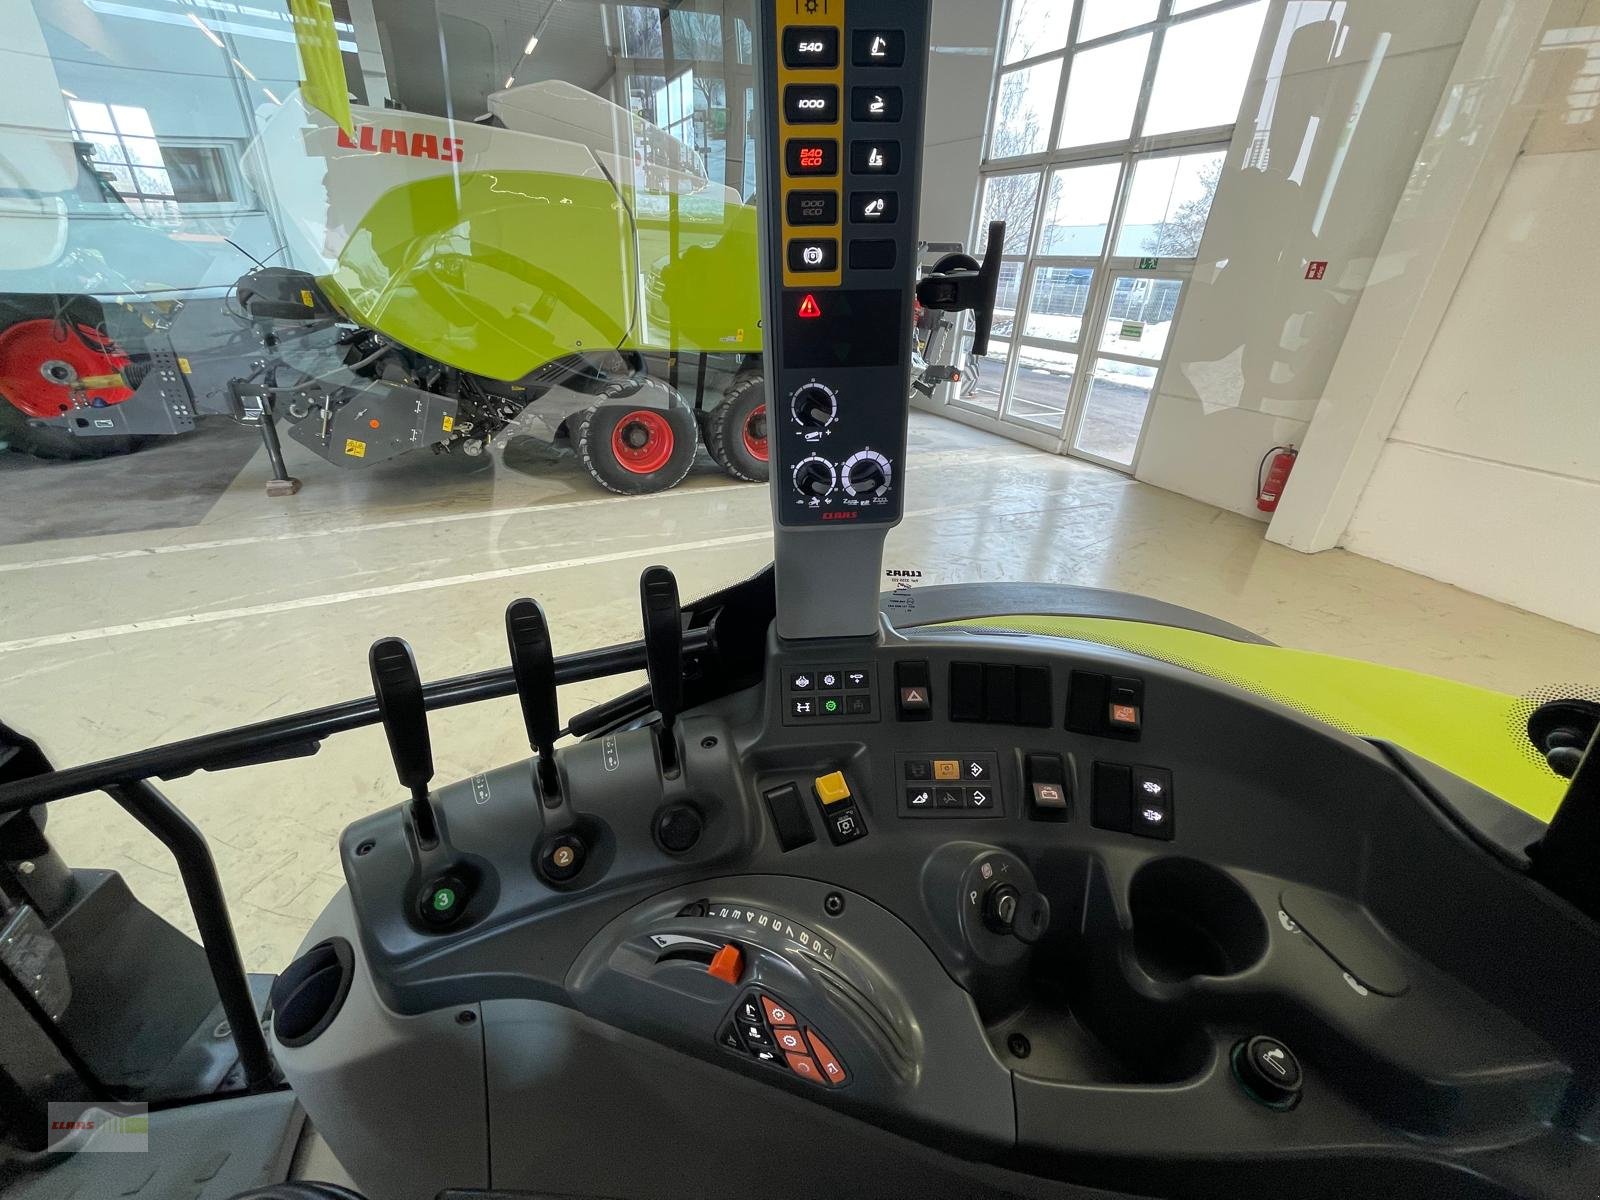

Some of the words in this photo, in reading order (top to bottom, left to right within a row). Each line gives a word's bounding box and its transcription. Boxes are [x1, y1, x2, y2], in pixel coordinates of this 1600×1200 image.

[799, 42, 823, 52] 540
[799, 99, 825, 109] 1000
[801, 149, 823, 157] 540
[801, 157, 823, 166] ECO
[801, 200, 825, 208] 1000
[822, 512, 858, 520] CLAAS
[559, 850, 569, 864] 2
[438, 892, 449, 906] 3
